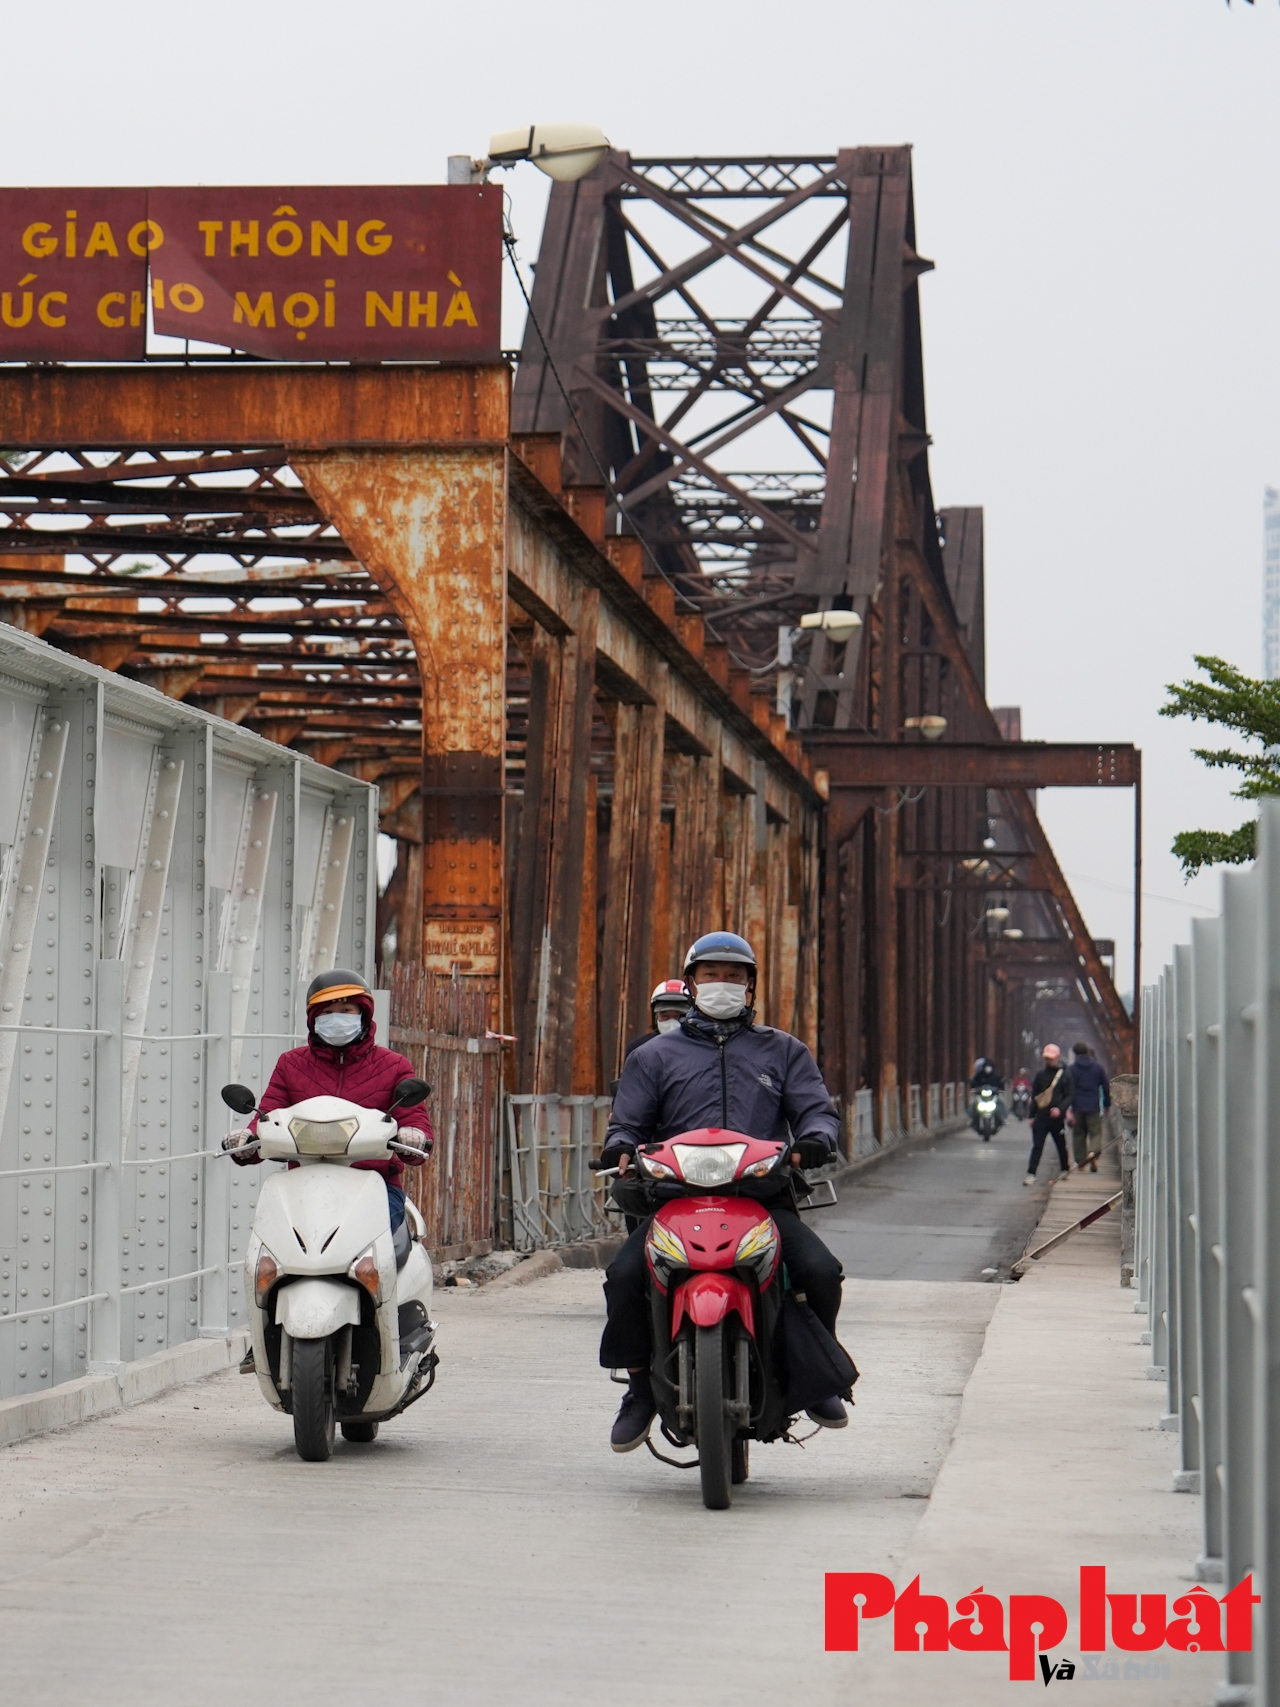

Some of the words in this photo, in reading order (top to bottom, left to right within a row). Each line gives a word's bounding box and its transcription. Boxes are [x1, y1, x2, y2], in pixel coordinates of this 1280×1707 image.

[198, 205, 393, 257] THÔNG
[97, 278, 205, 329] CHO
[365, 270, 478, 328] NHÀ
